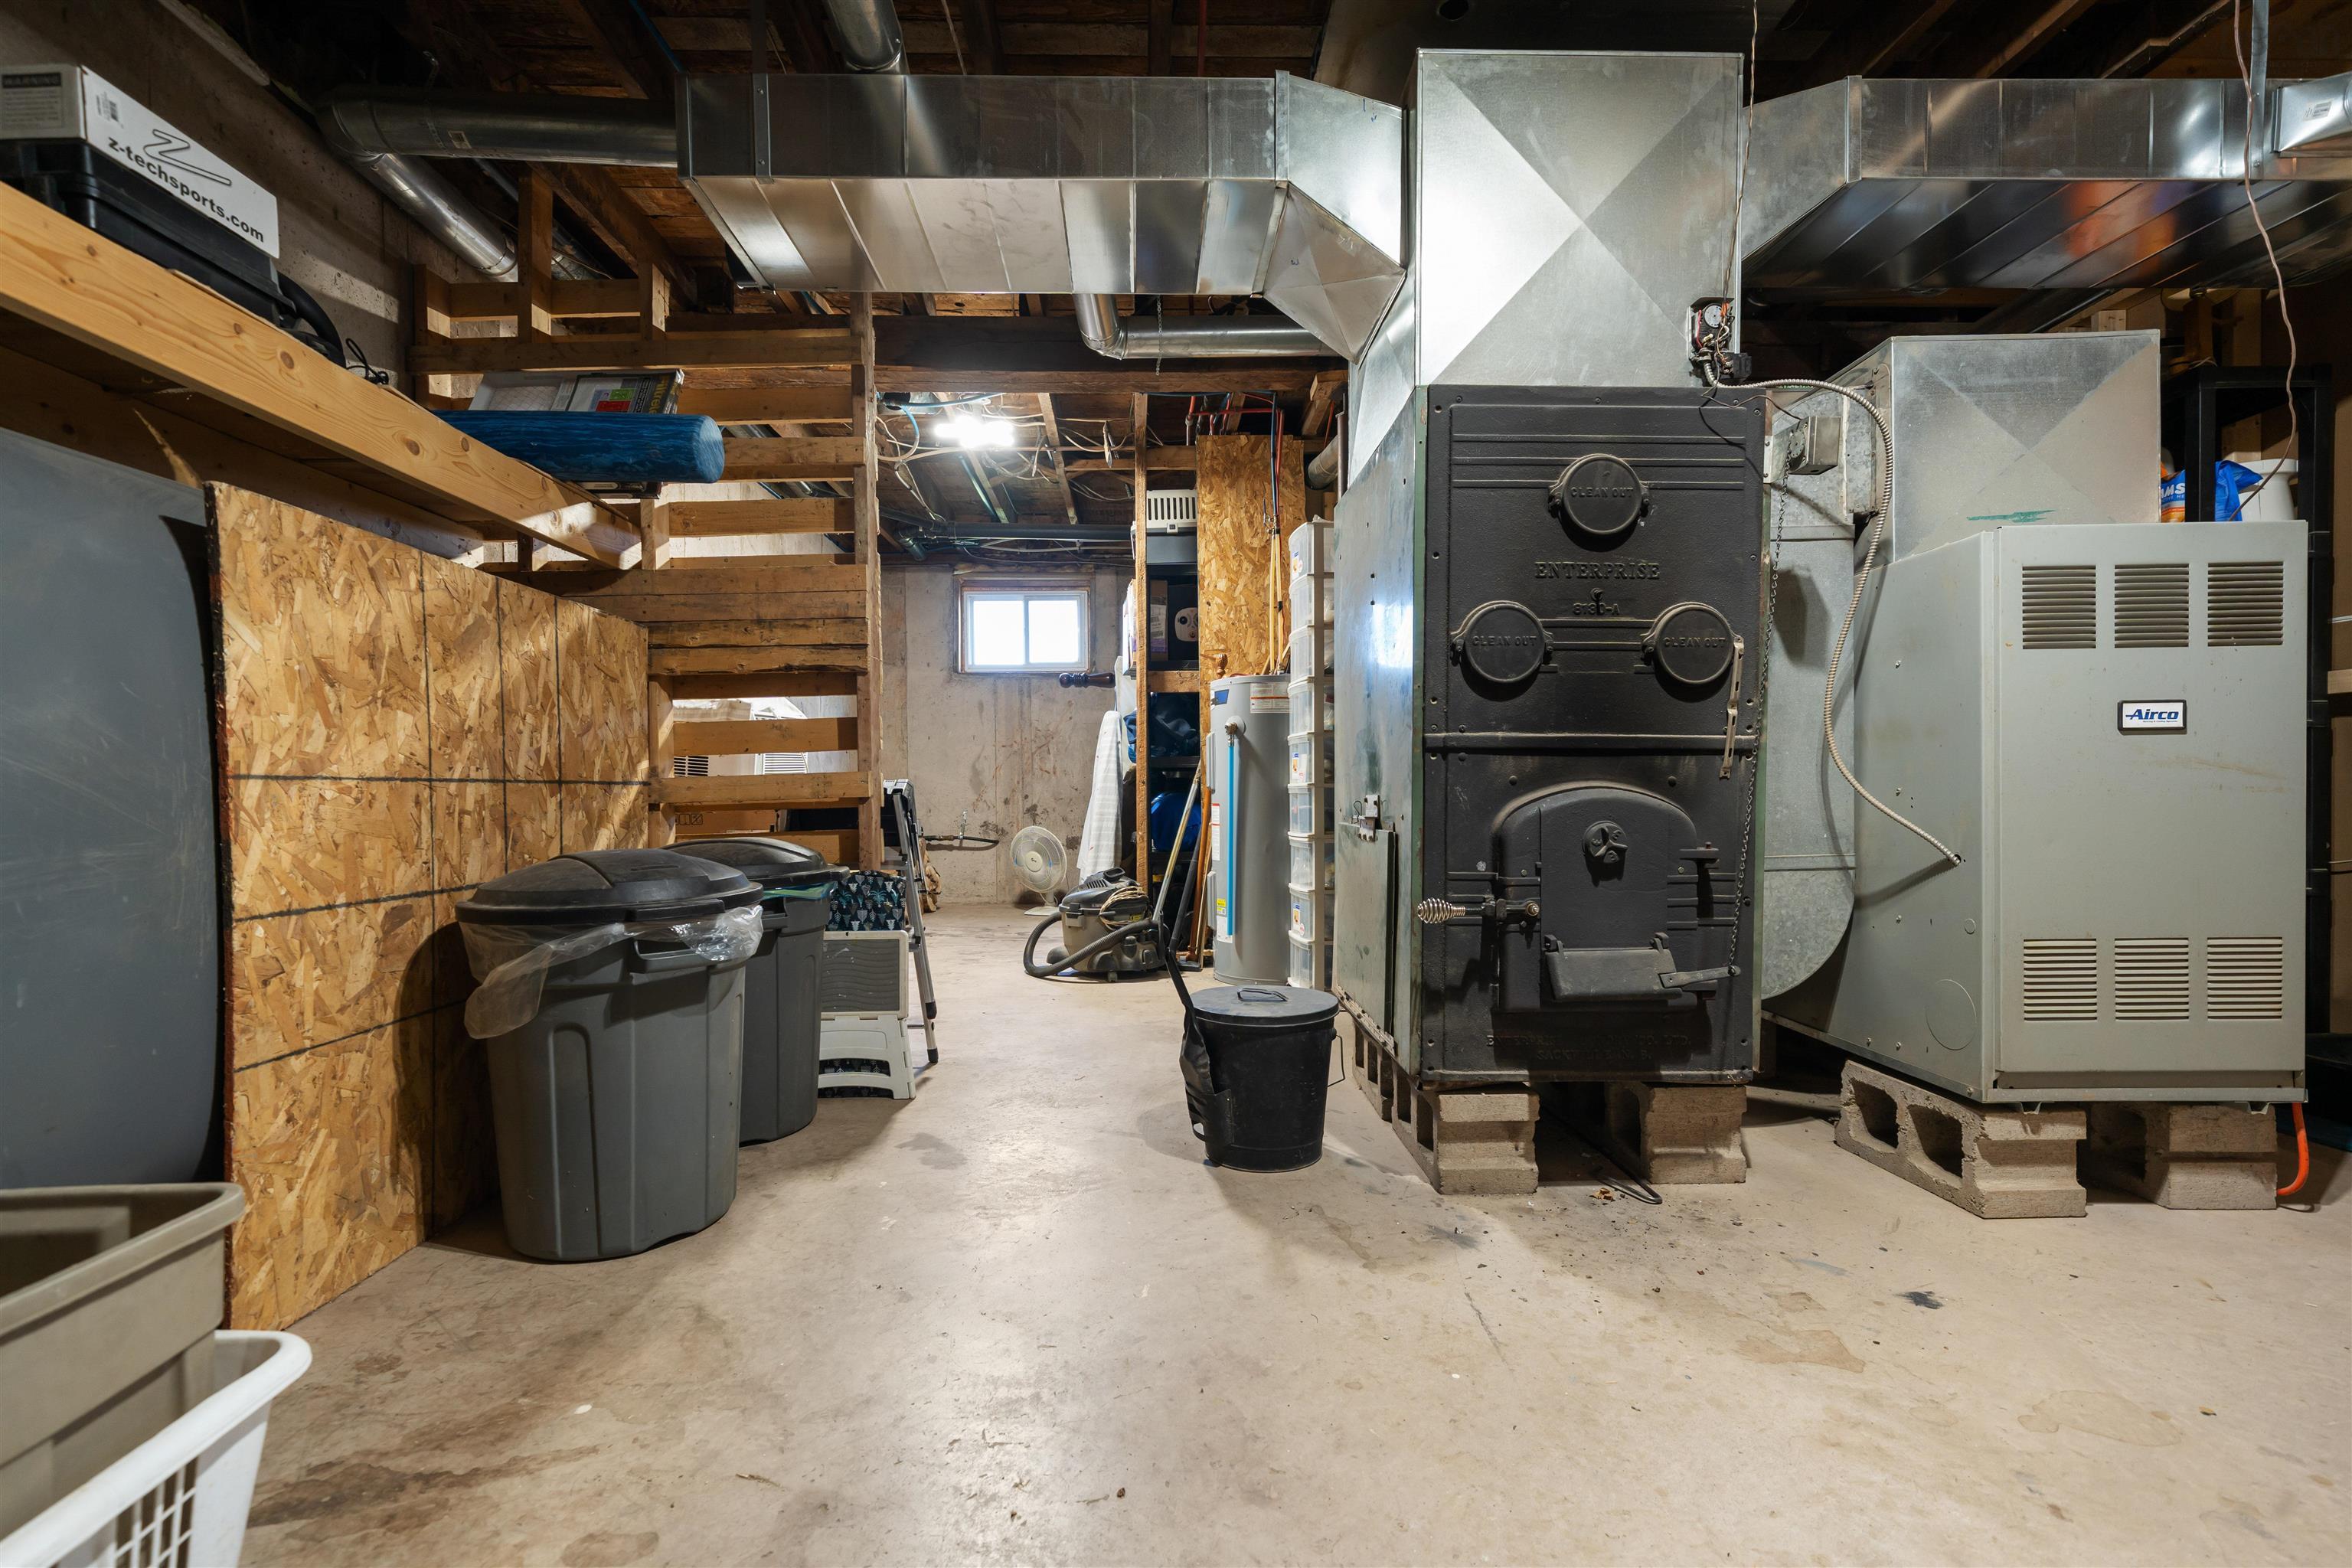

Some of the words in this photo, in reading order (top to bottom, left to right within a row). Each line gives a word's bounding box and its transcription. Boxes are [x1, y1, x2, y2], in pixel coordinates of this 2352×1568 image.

[108, 136, 264, 243] z-techsports.com
[1571, 487, 1609, 498] CLEAN
[1612, 487, 1634, 498] OUT
[1534, 561, 1661, 580] ENTERPRISE
[1472, 635, 1511, 646] CLEAN
[1515, 635, 1537, 646] OUT
[1664, 637, 1701, 648] CLEAN
[1704, 637, 1726, 648] OUT
[2125, 708, 2180, 720] Airco
